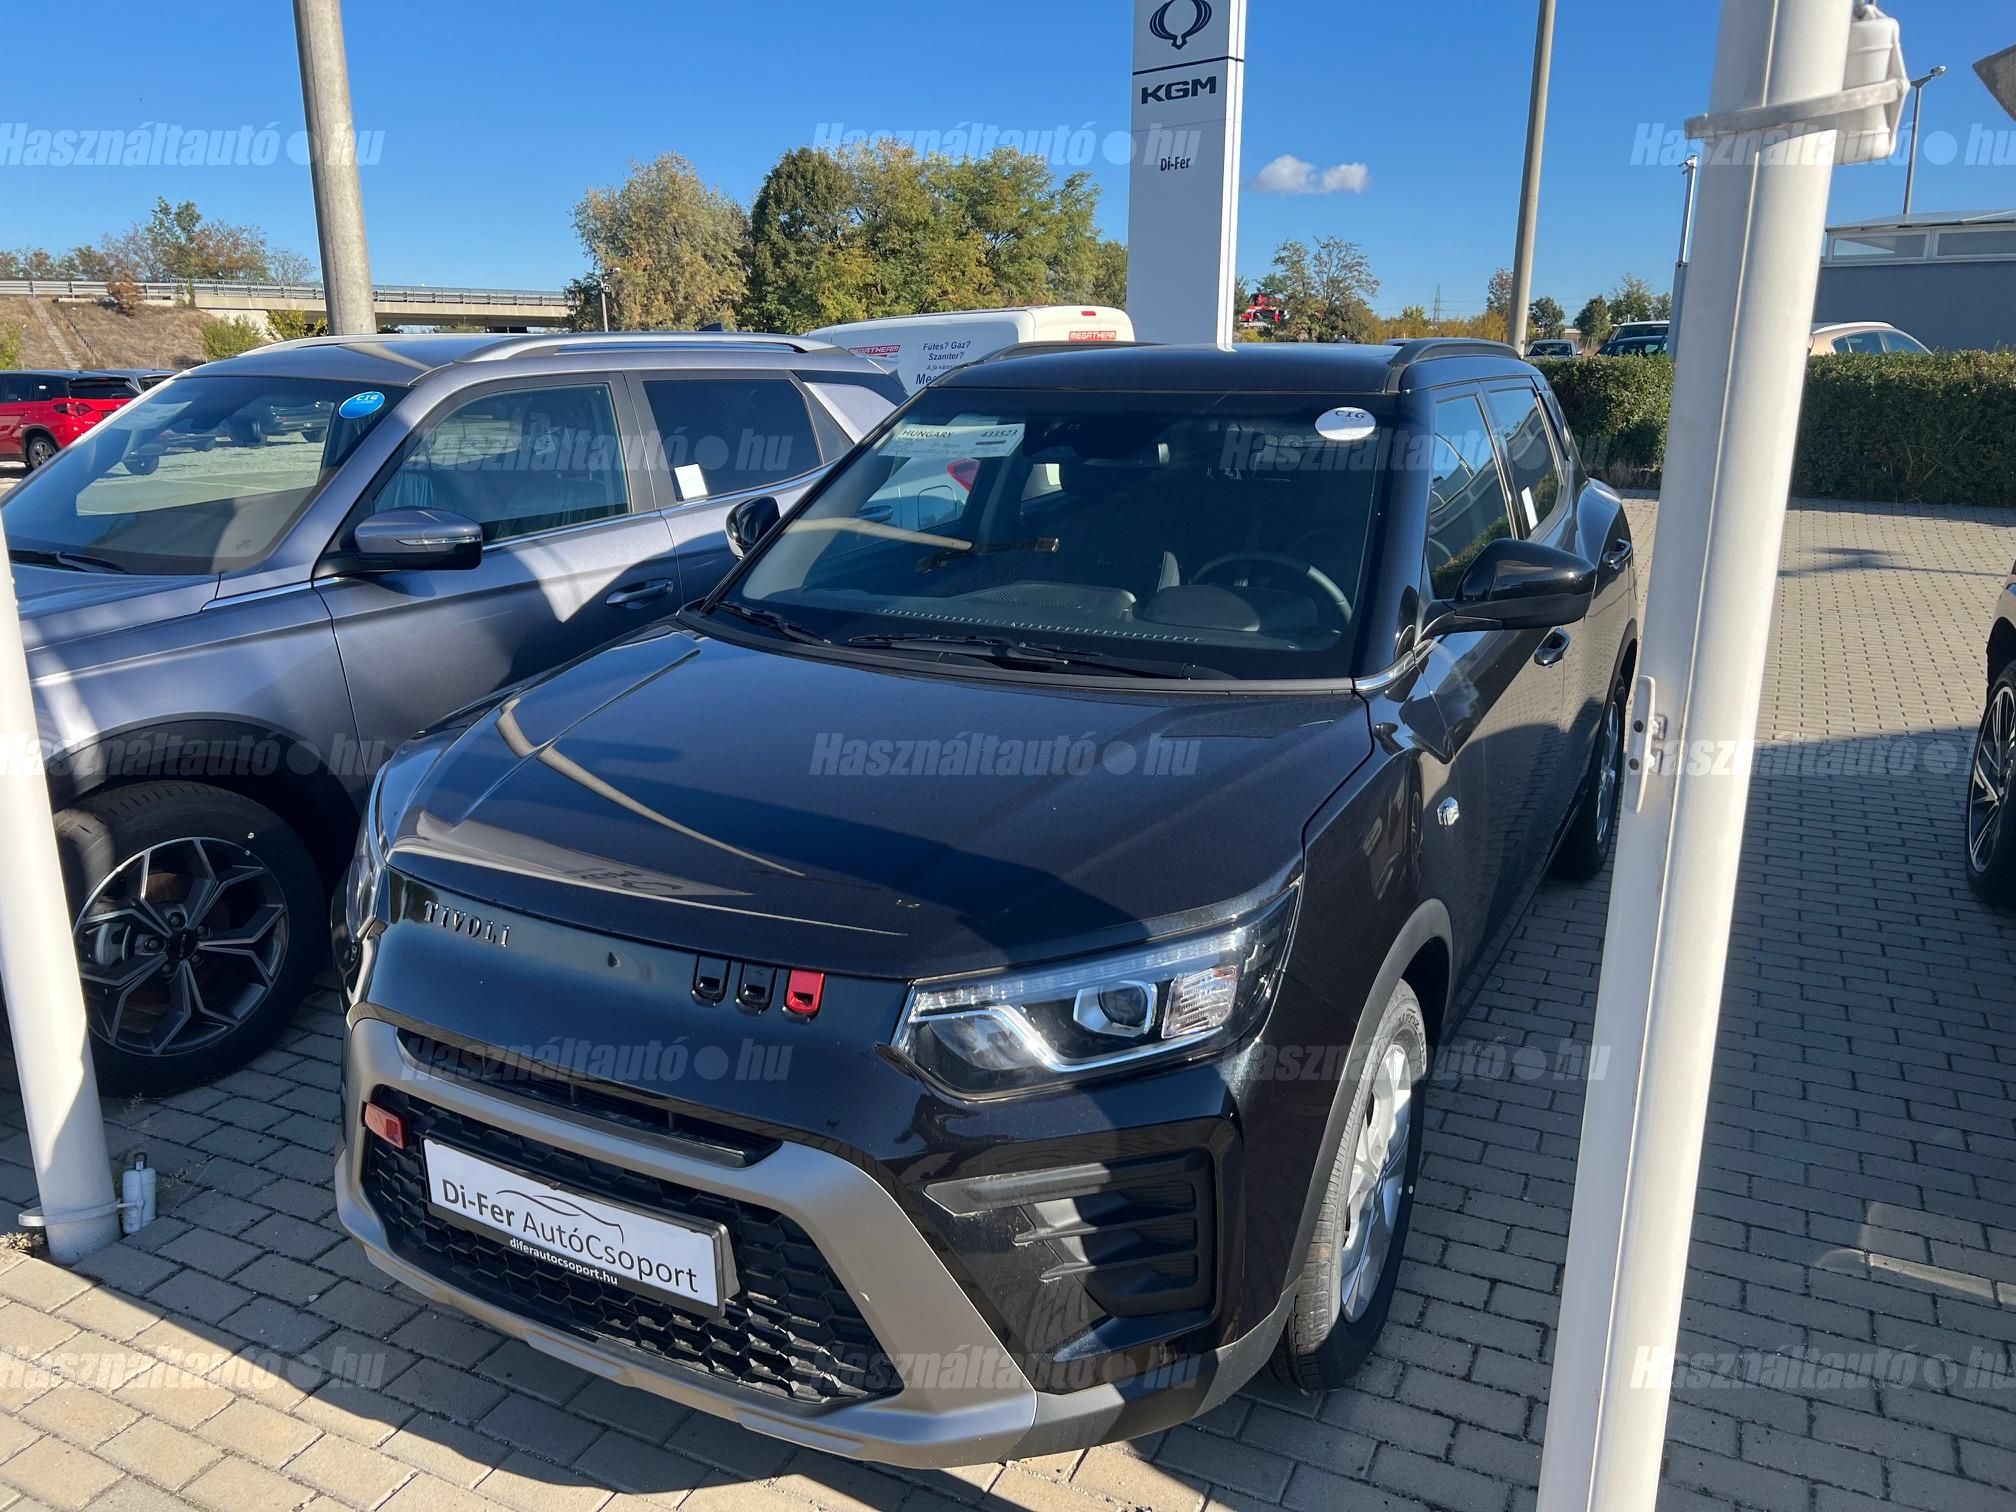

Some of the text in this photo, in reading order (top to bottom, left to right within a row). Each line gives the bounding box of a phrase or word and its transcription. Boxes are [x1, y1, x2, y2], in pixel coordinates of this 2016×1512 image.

[1141, 76, 1217, 105] KGM
[1160, 156, 1191, 172] Di-Fer
[1335, 410, 1365, 419] CIG
[901, 429, 954, 438] HUNGARY
[424, 900, 510, 948] TIVOLI
[442, 1178, 699, 1293] Di-Fer AutóCsoport
[509, 1237, 618, 1286] diferautocsoport.hu
